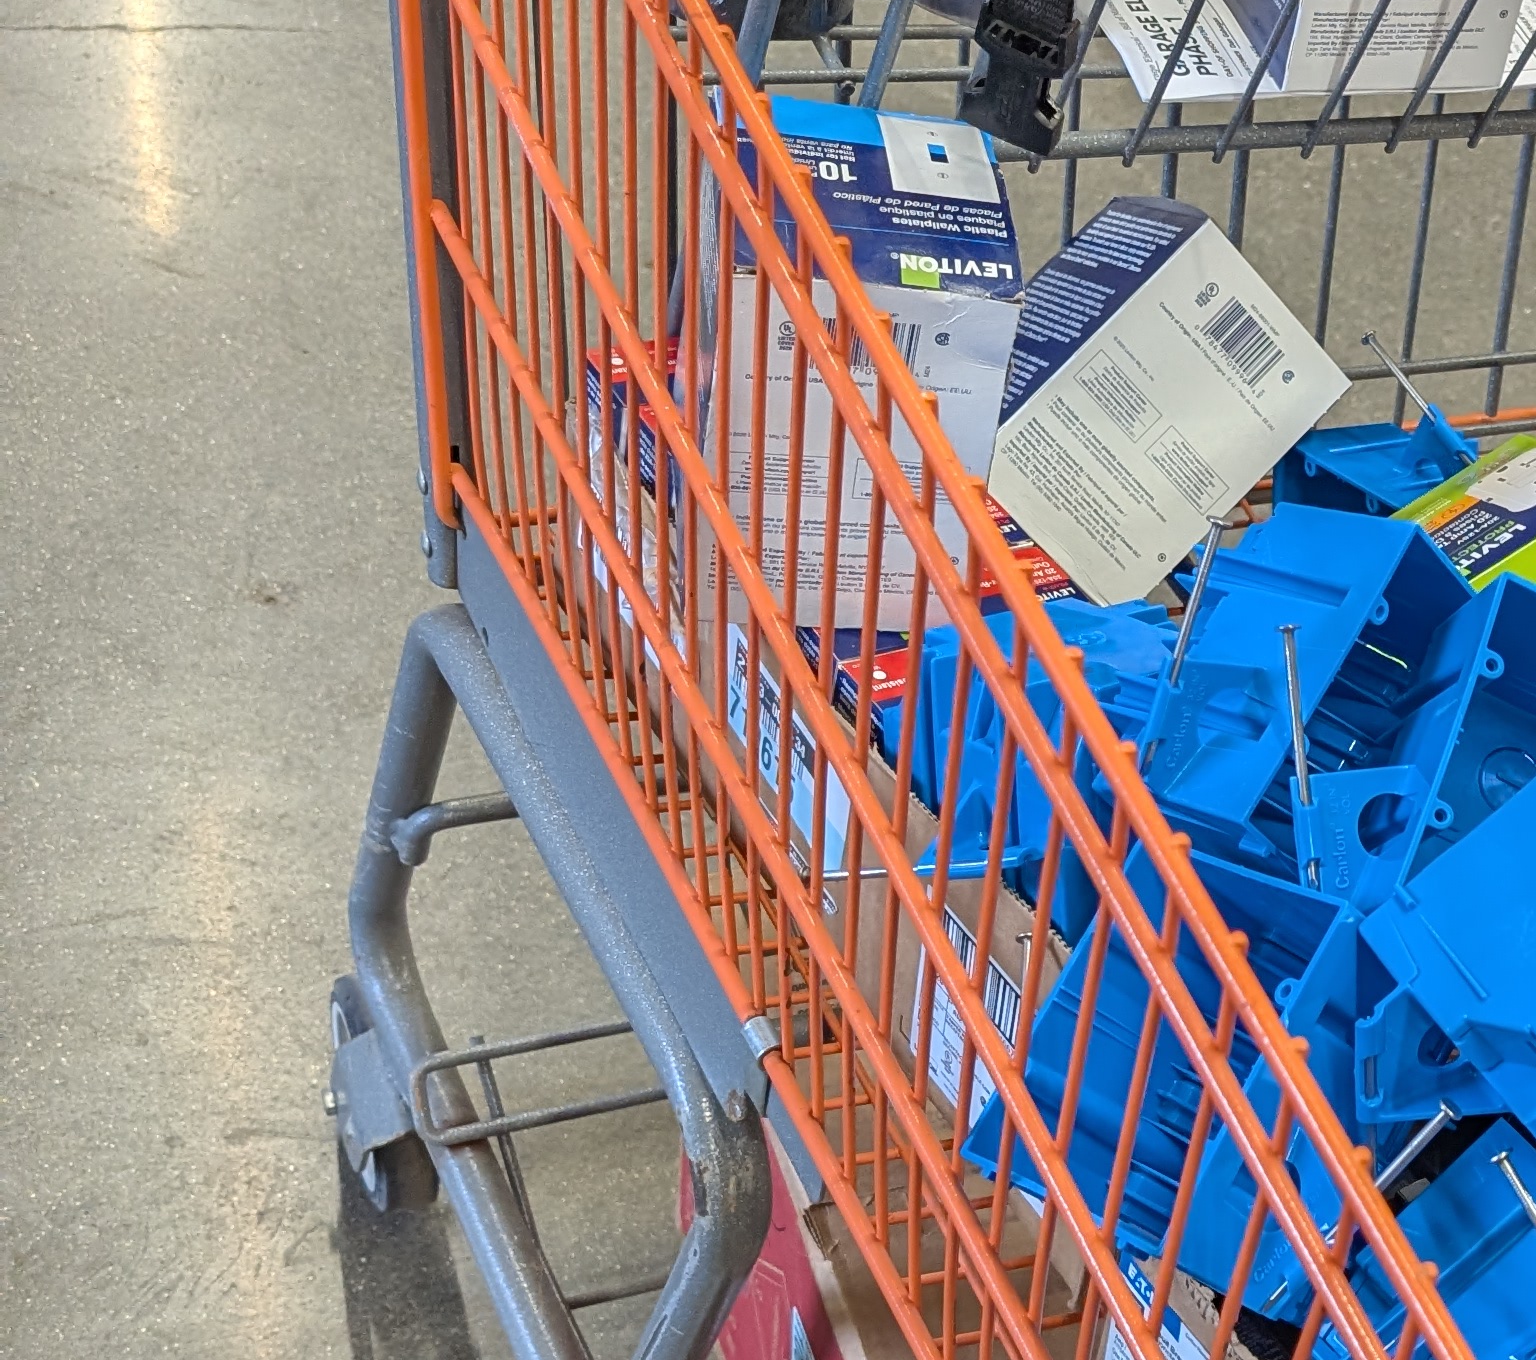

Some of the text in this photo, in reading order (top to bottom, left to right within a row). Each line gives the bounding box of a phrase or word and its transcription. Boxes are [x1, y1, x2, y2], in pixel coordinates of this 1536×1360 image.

[786, 147, 823, 157] individu
[818, 159, 857, 182] 10
[832, 190, 1003, 218] Placas de Pared de Plástico
[878, 204, 1005, 227] Plaques en plastique
[891, 216, 1007, 238] Plastic Wallplates
[1158, 301, 1176, 320] Country
[1190, 336, 1201, 349] USA
[1204, 334, 1227, 359] 78477
[1226, 359, 1249, 384] 09996
[1056, 396, 1066, 407] May
[1064, 405, 1080, 422] include
[1078, 420, 1087, 430] one
[1091, 433, 1103, 446] more
[1100, 444, 1118, 462] globally
[1116, 460, 1132, 477] sourced
[1451, 518, 1514, 563] PROTECT
[1456, 522, 1524, 571] LEVIT
[1333, 828, 1349, 887] Carlon
[1251, 1237, 1292, 1282] Carlo
